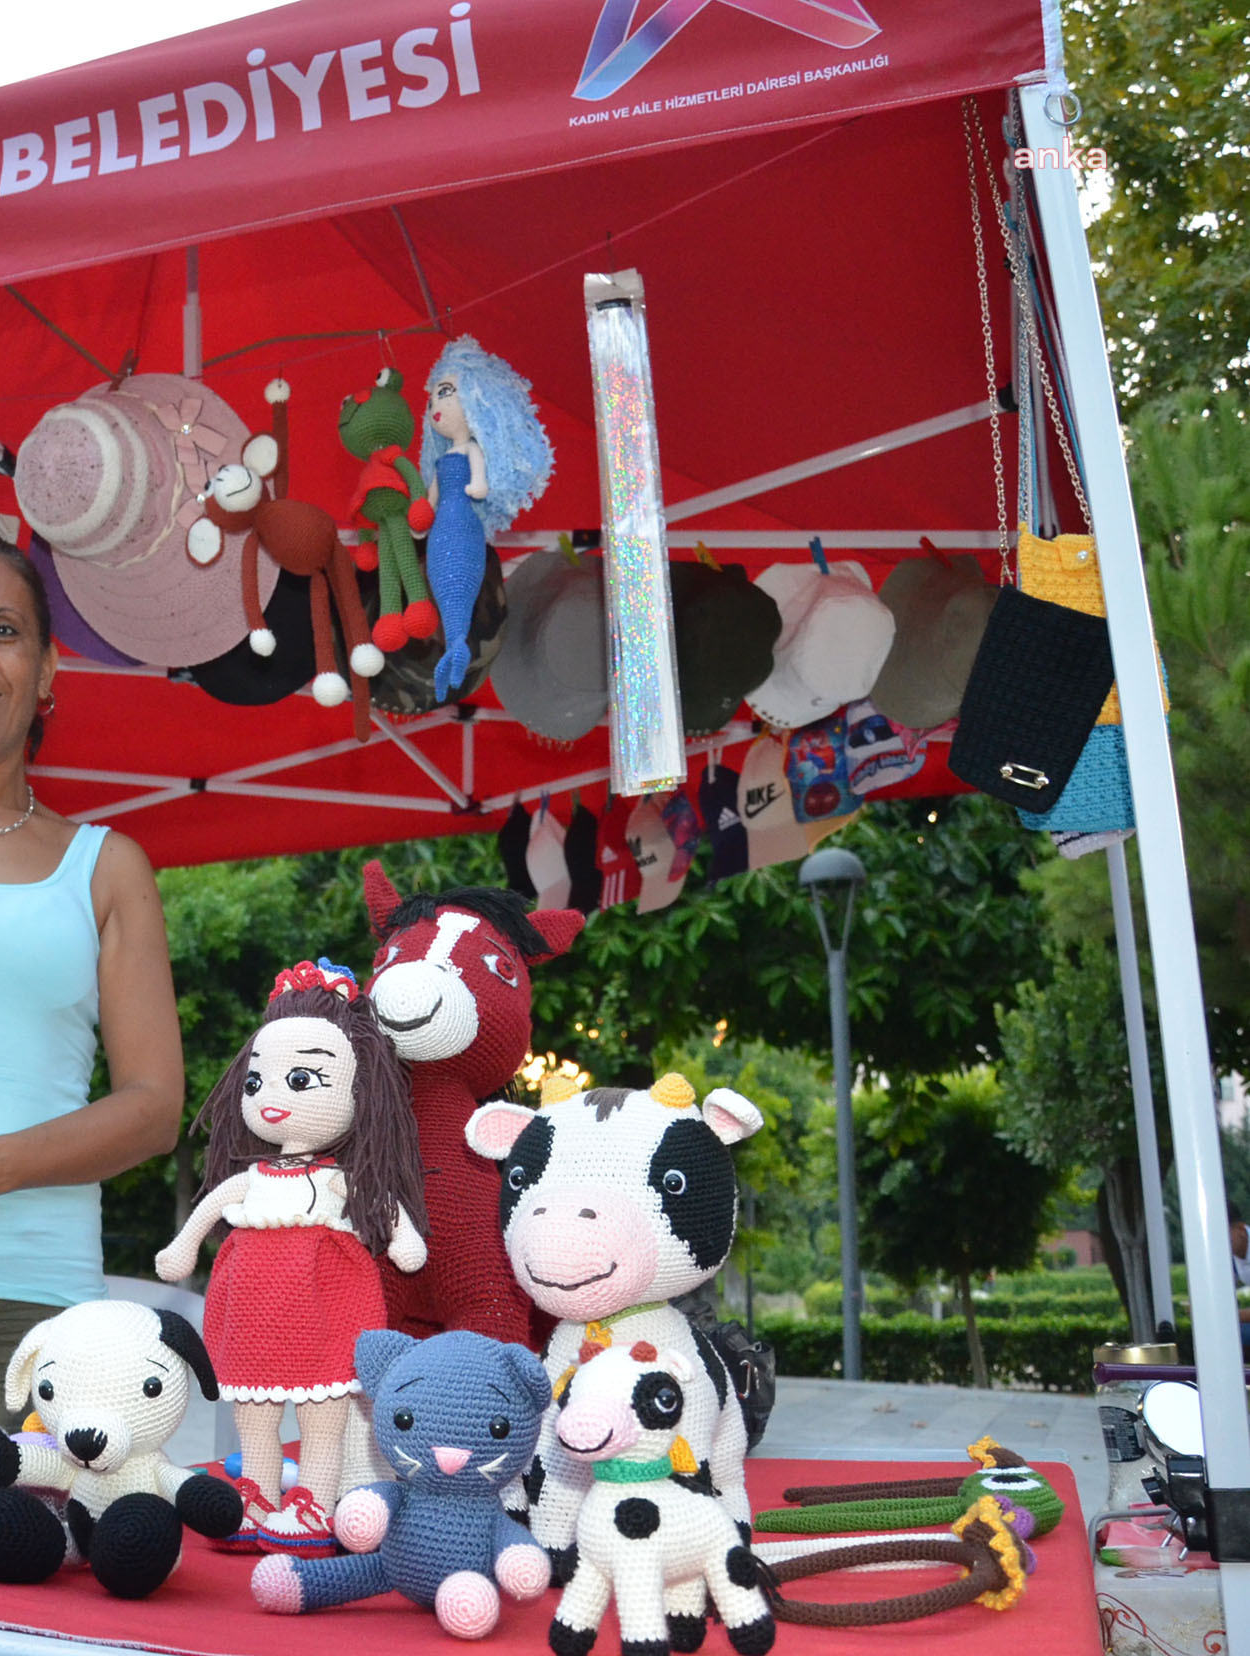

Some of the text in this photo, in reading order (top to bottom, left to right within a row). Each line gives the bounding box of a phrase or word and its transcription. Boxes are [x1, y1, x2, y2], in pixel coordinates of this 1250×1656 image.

[568, 53, 890, 128] KADIN VE AİLE HİZMETLERİ DAİRESİ BAŞKANLIĞI
